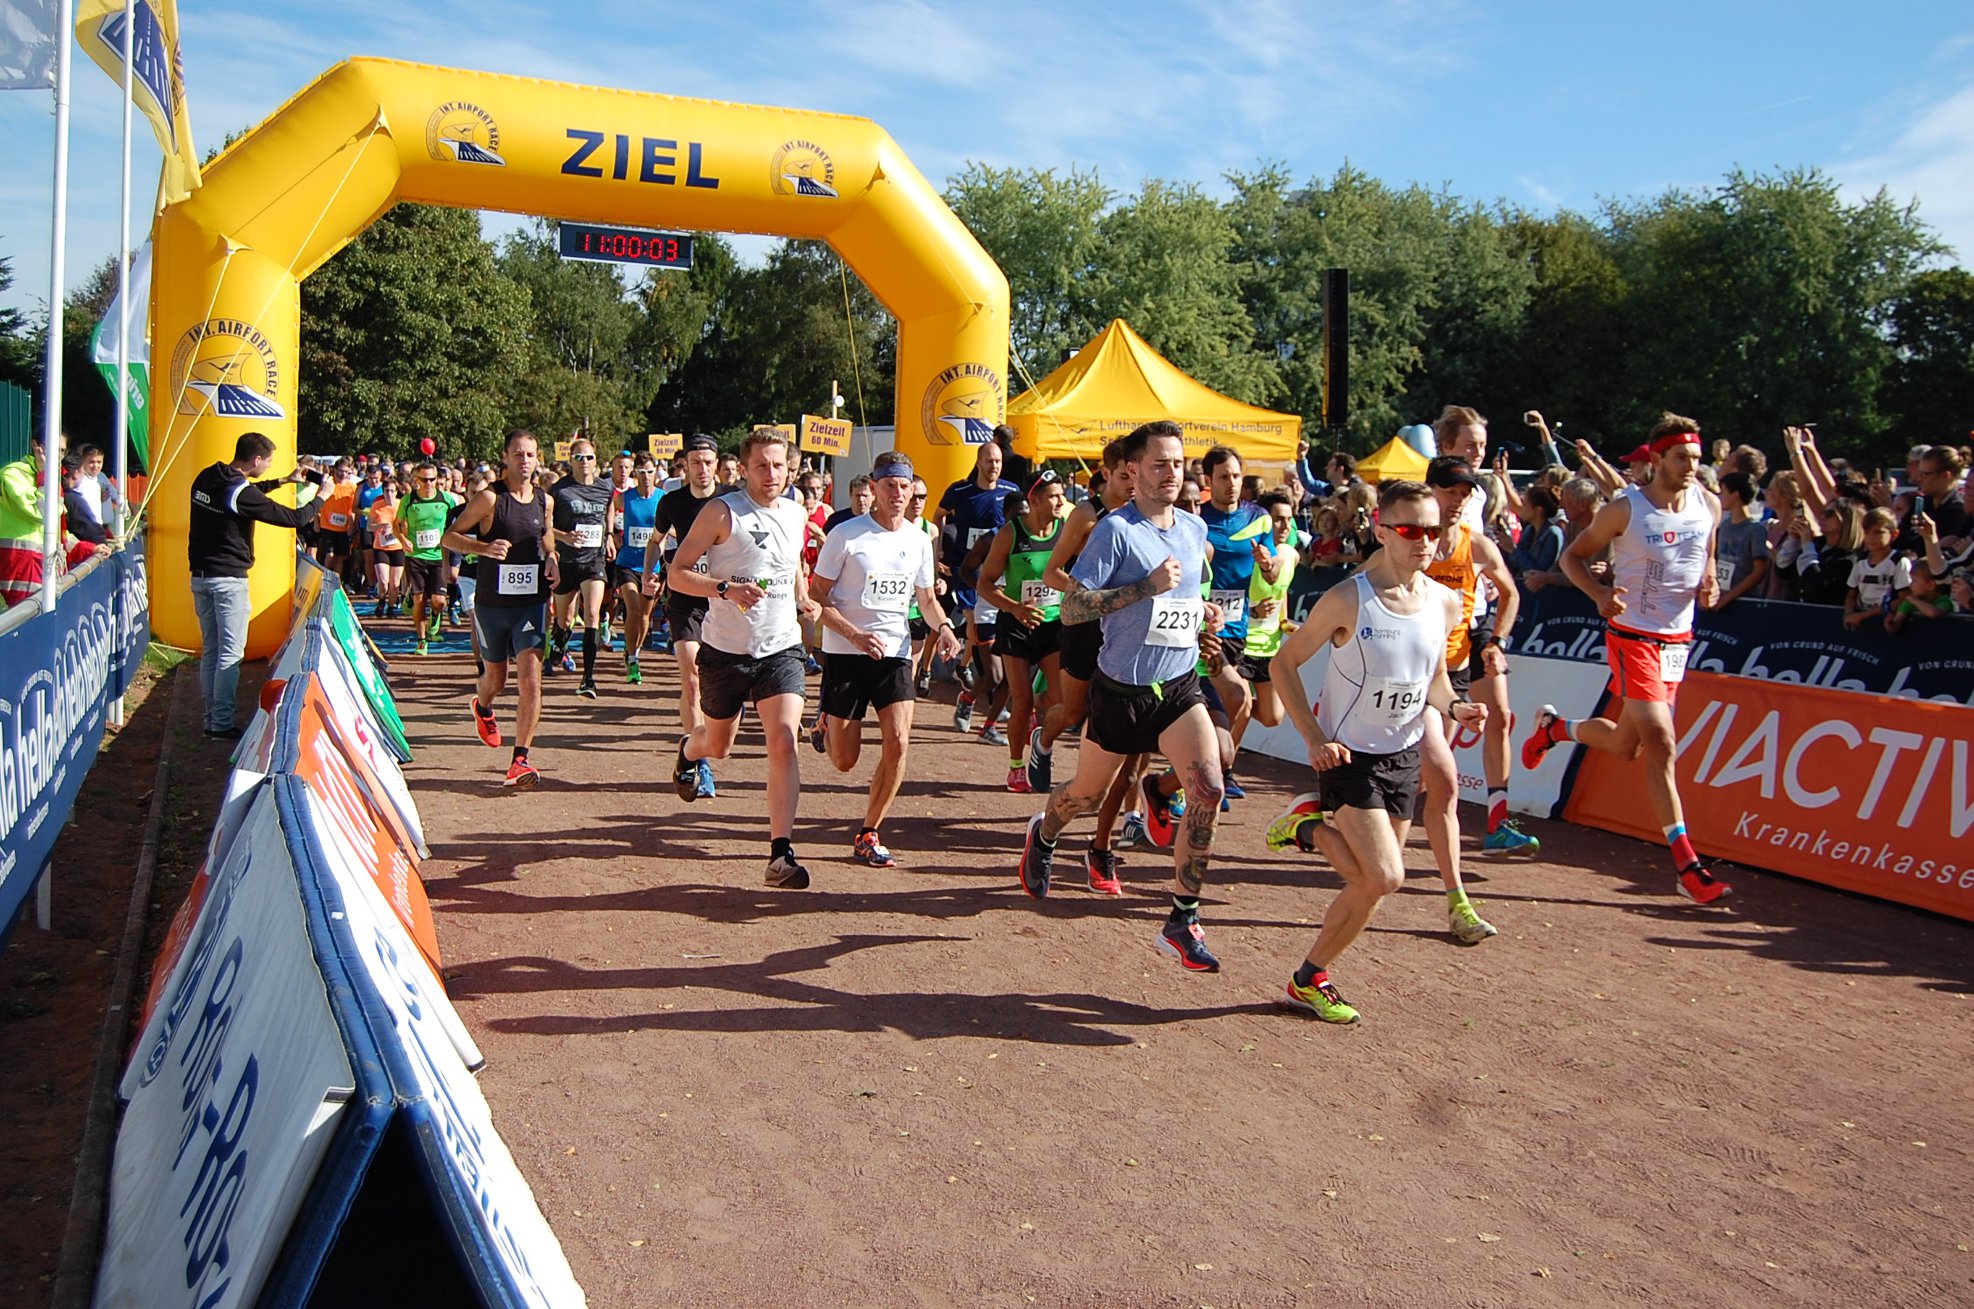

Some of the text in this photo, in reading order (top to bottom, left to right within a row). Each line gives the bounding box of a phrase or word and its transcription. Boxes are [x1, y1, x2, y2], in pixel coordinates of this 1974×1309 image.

[457, 101, 494, 126] AIRPORT
[488, 127, 499, 152] RACE
[561, 128, 720, 189] ZIEL
[797, 140, 829, 161] AIRPORT
[583, 232, 679, 262] 11:00:03
[218, 320, 273, 357] AIRPORT
[265, 360, 278, 397] RACE
[939, 367, 963, 384] INT.
[964, 364, 1002, 393] AIRPORT
[809, 421, 846, 437] Zielzeit
[1179, 422, 1228, 432] ortverein
[1231, 423, 1282, 434] Hamburg
[653, 438, 679, 447] Zielzeit
[811, 435, 841, 448] 60 Min.
[1645, 531, 1705, 545] TRI TEAM
[508, 571, 532, 585] 895
[871, 580, 907, 595] 1532
[1156, 610, 1198, 630] 2231
[1712, 630, 1739, 646] FRISCH
[1770, 641, 1881, 666] VON GRUND AUF FRISCH
[1917, 661, 1941, 671] VON
[1373, 688, 1423, 710] 1194
[17, 688, 53, 814] hella
[1733, 811, 1974, 889] Krankenkasse
